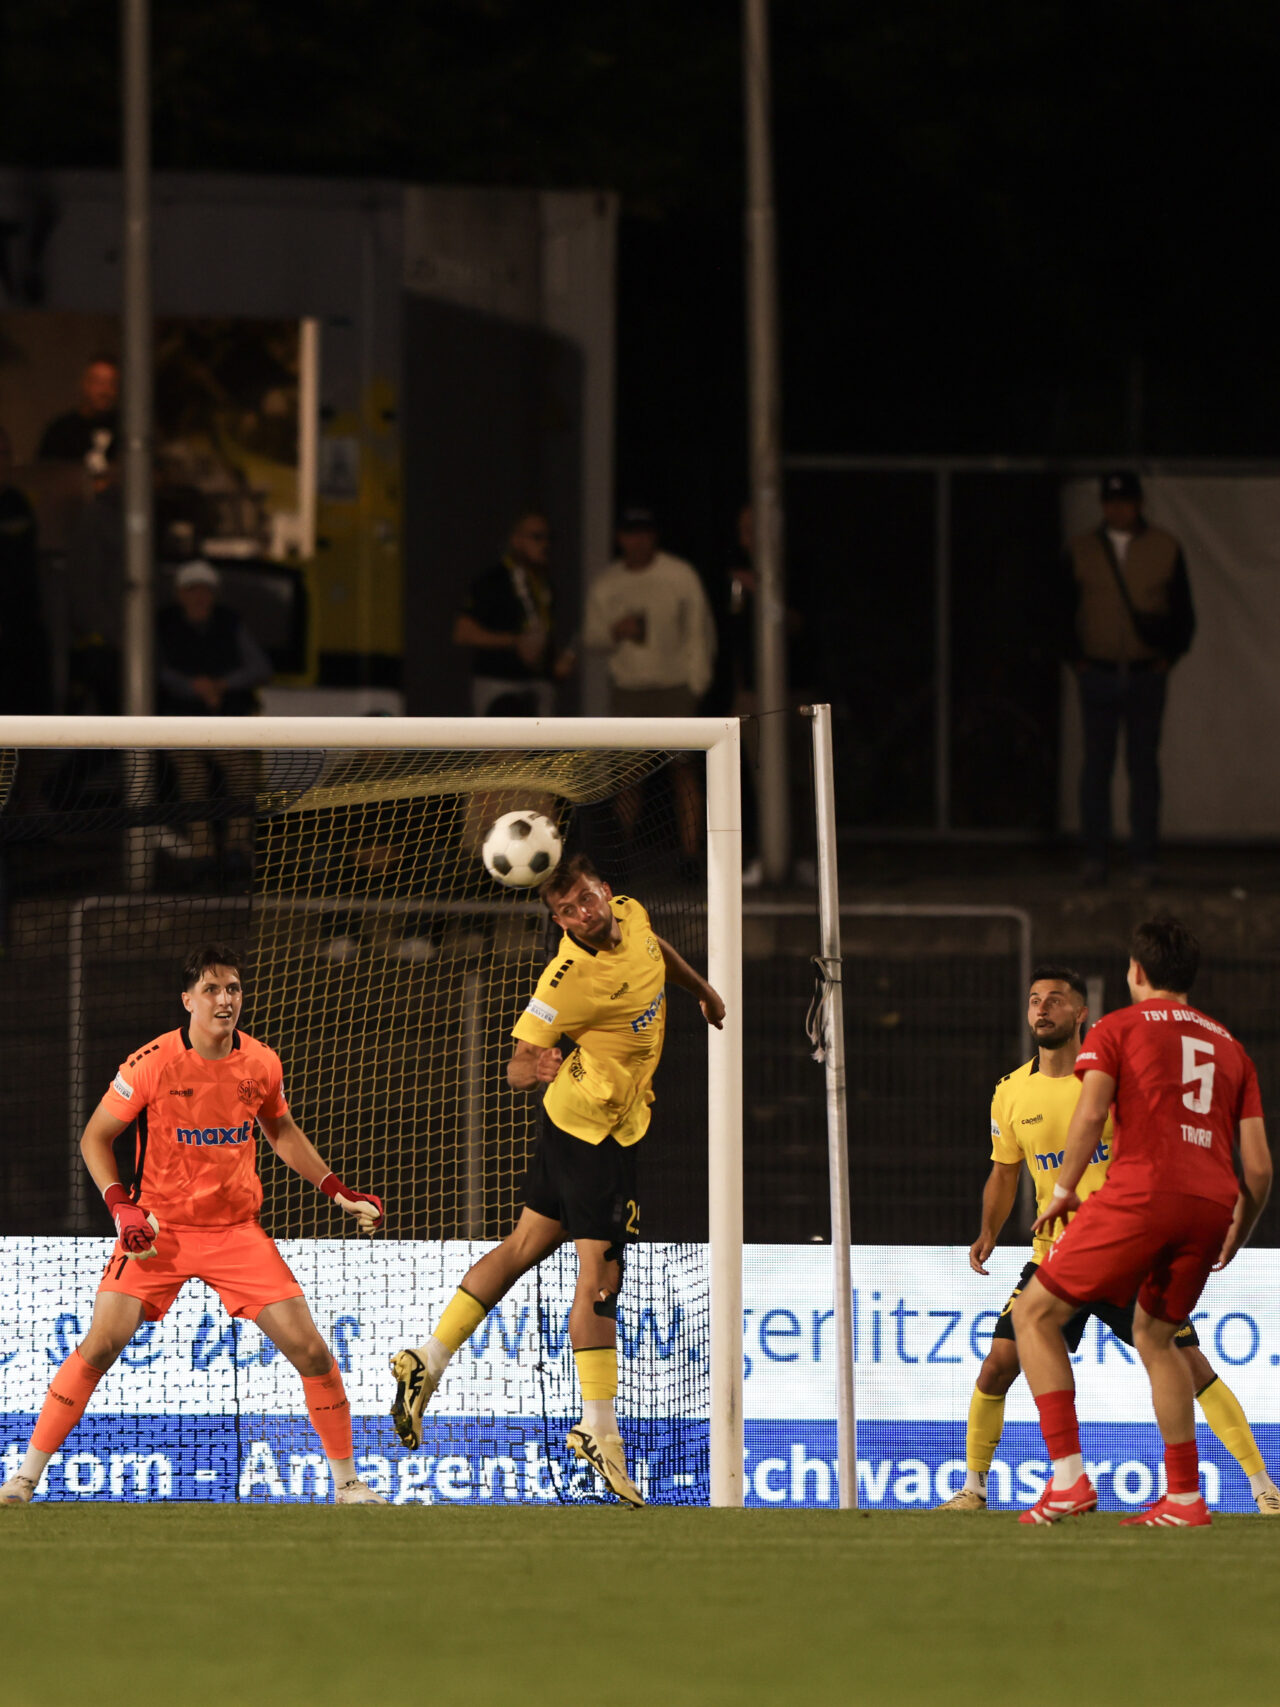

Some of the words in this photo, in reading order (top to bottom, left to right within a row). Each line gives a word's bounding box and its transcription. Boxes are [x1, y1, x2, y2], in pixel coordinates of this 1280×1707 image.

[1141, 1009, 1168, 1022] TSV
[1181, 1035, 1215, 1115] 5
[176, 1121, 251, 1146] maxit
[1035, 1139, 1109, 1170] mit
[626, 1199, 640, 1235] 2
[45, 1312, 163, 1368] se
[192, 1312, 362, 1373] us
